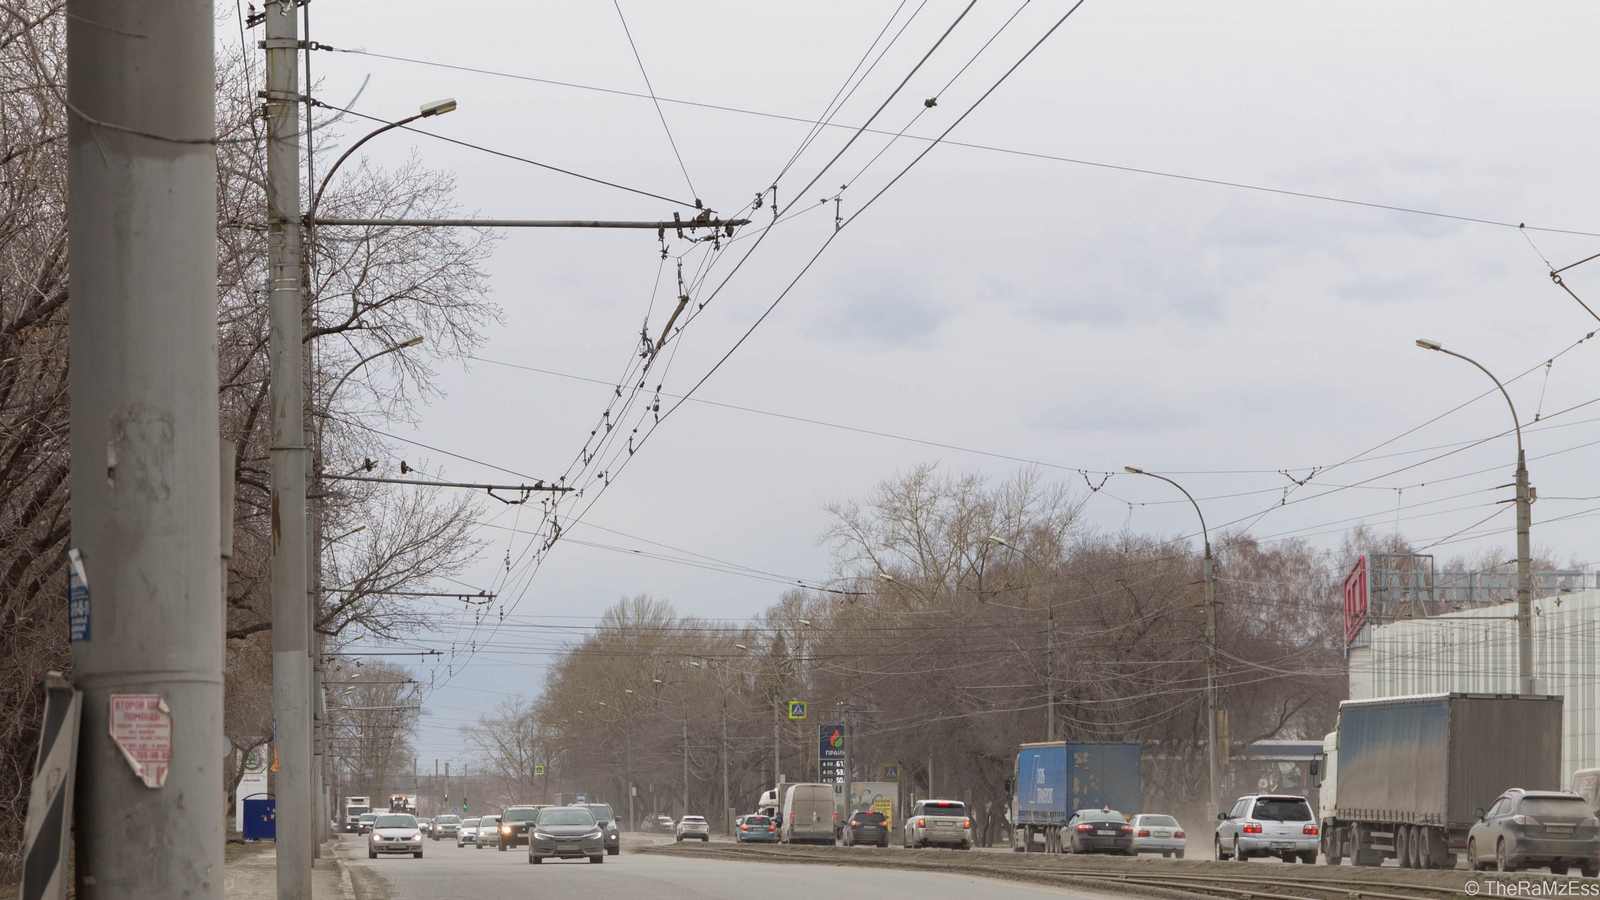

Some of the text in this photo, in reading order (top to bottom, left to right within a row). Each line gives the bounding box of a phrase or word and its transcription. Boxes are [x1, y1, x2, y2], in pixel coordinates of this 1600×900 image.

[115, 700, 160, 710] ВТОРОЙ ША
[123, 711, 160, 721] ПОМОЩЬ
